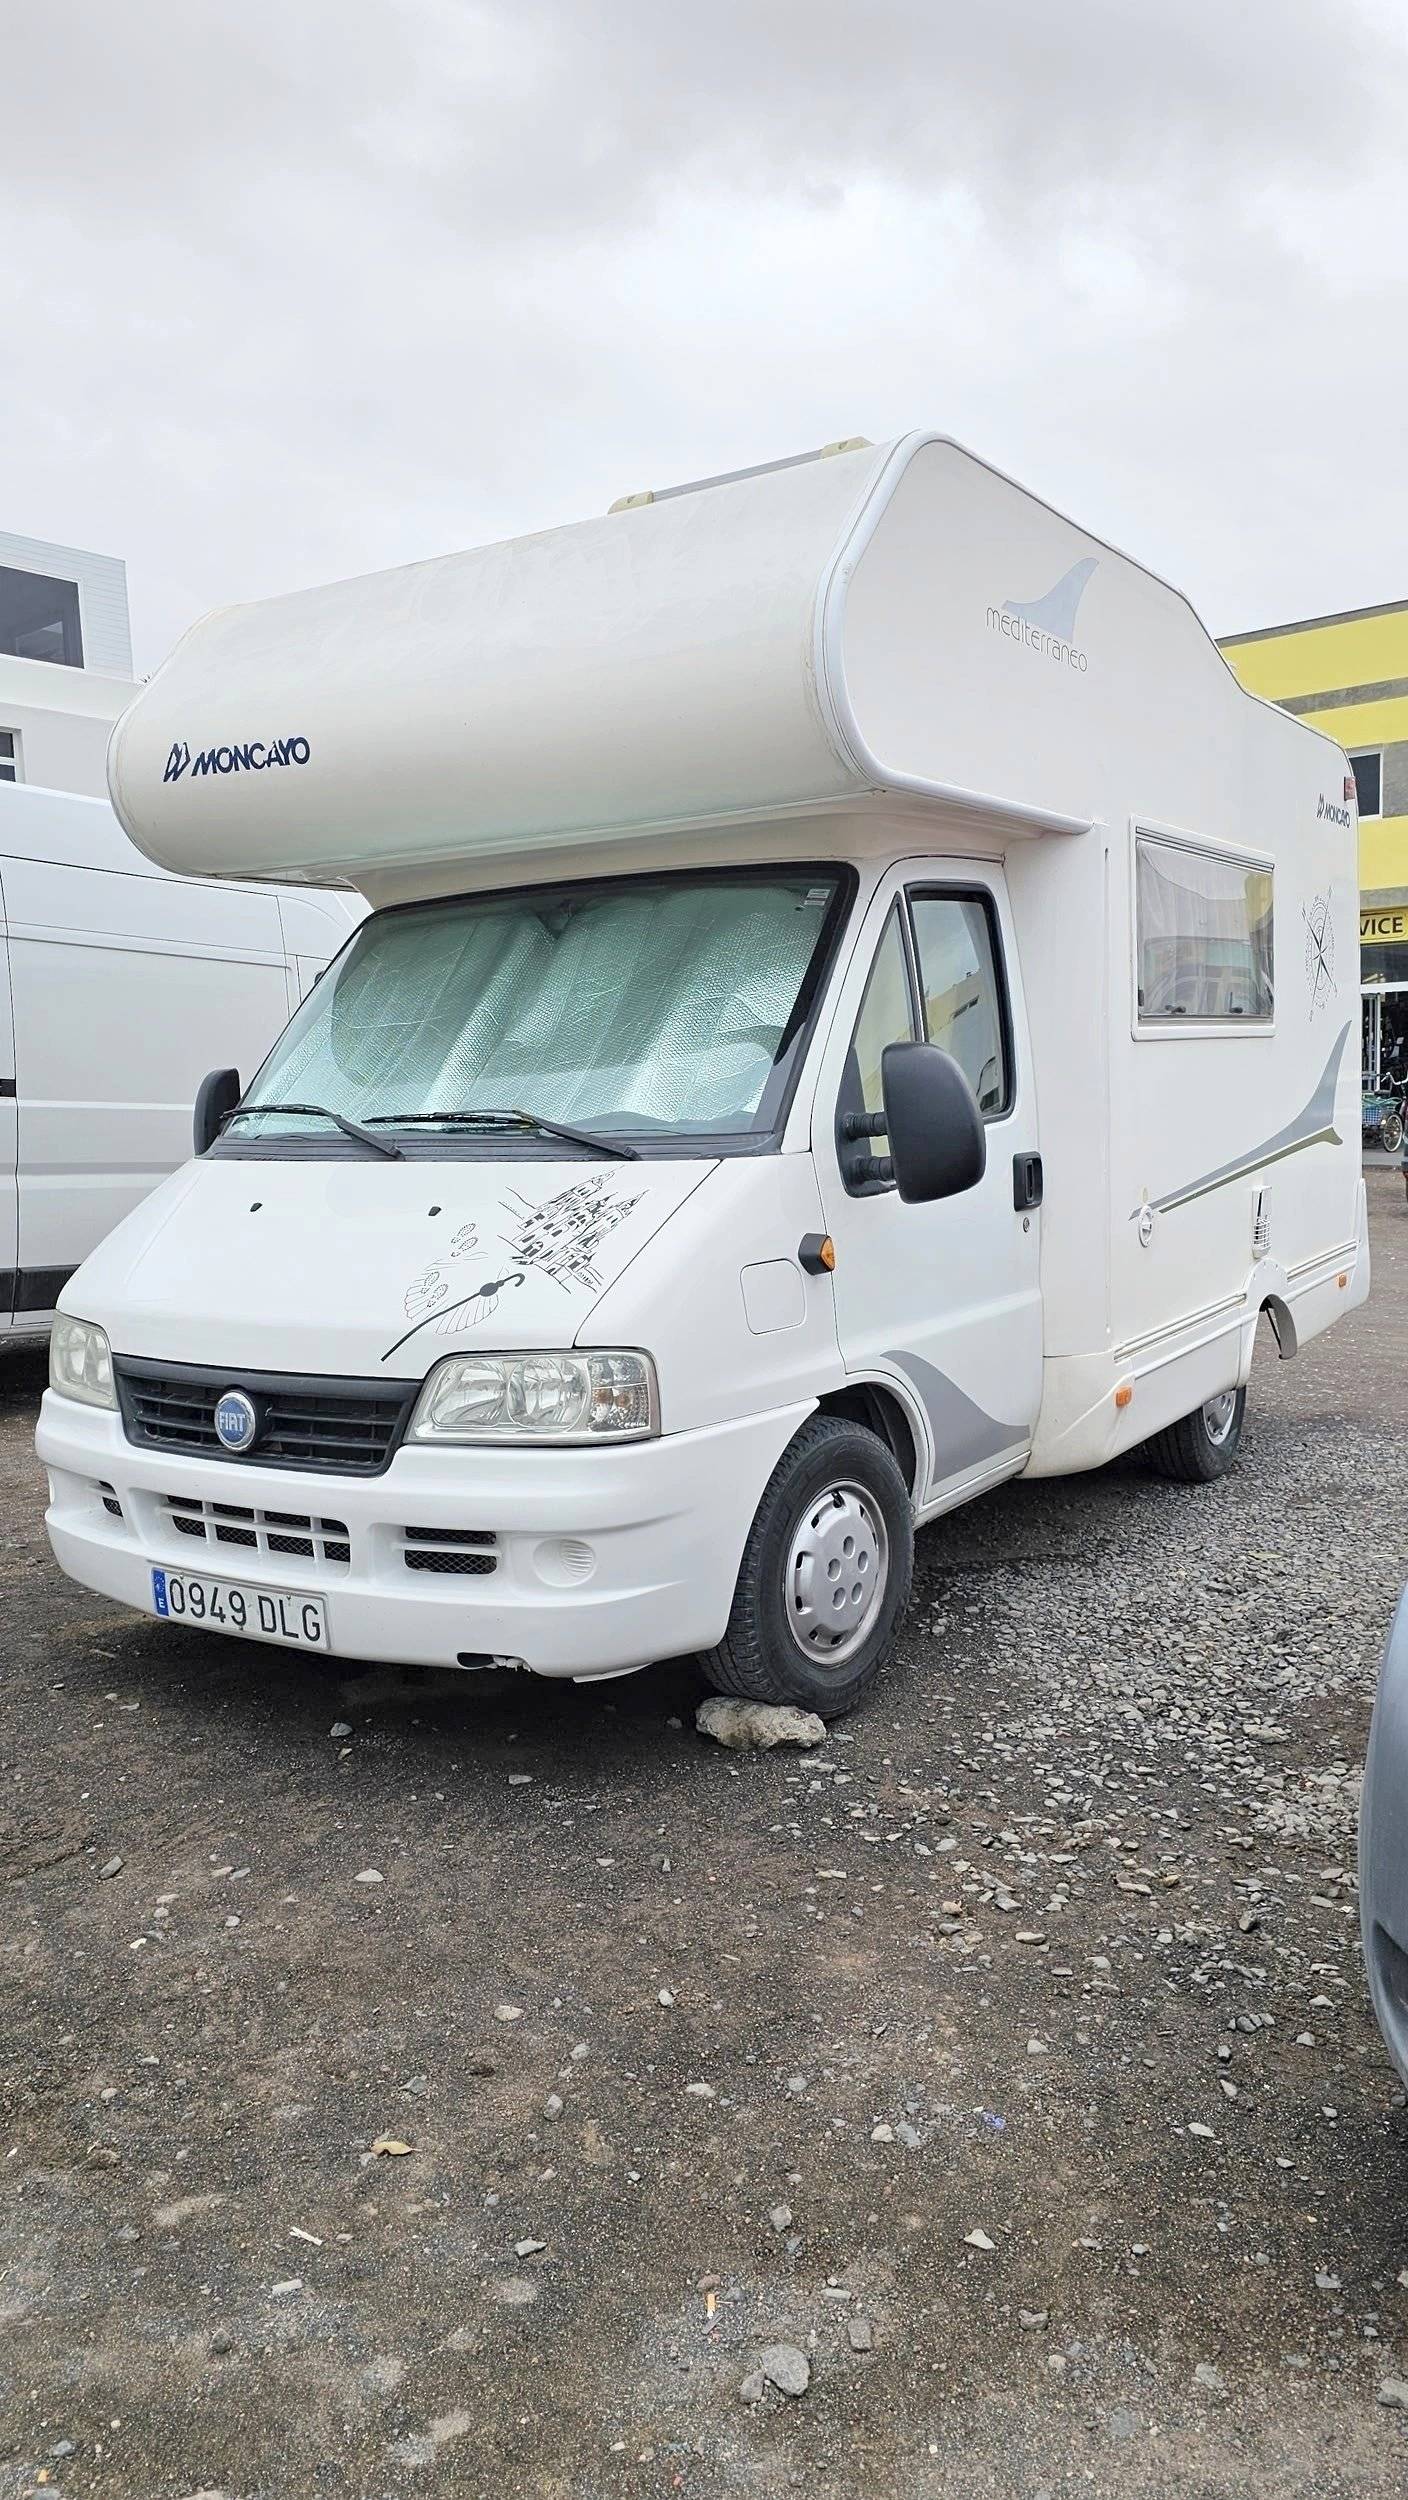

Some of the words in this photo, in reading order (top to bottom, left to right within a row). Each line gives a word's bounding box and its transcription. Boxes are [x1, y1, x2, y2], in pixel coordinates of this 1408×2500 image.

[986, 606, 1088, 672] mediterraneo
[191, 737, 310, 776] MONCAYO
[219, 1411, 245, 1431] FIAT
[158, 1597, 166, 1608] E
[169, 1578, 247, 1627] 0949
[257, 1594, 321, 1642] DLG
